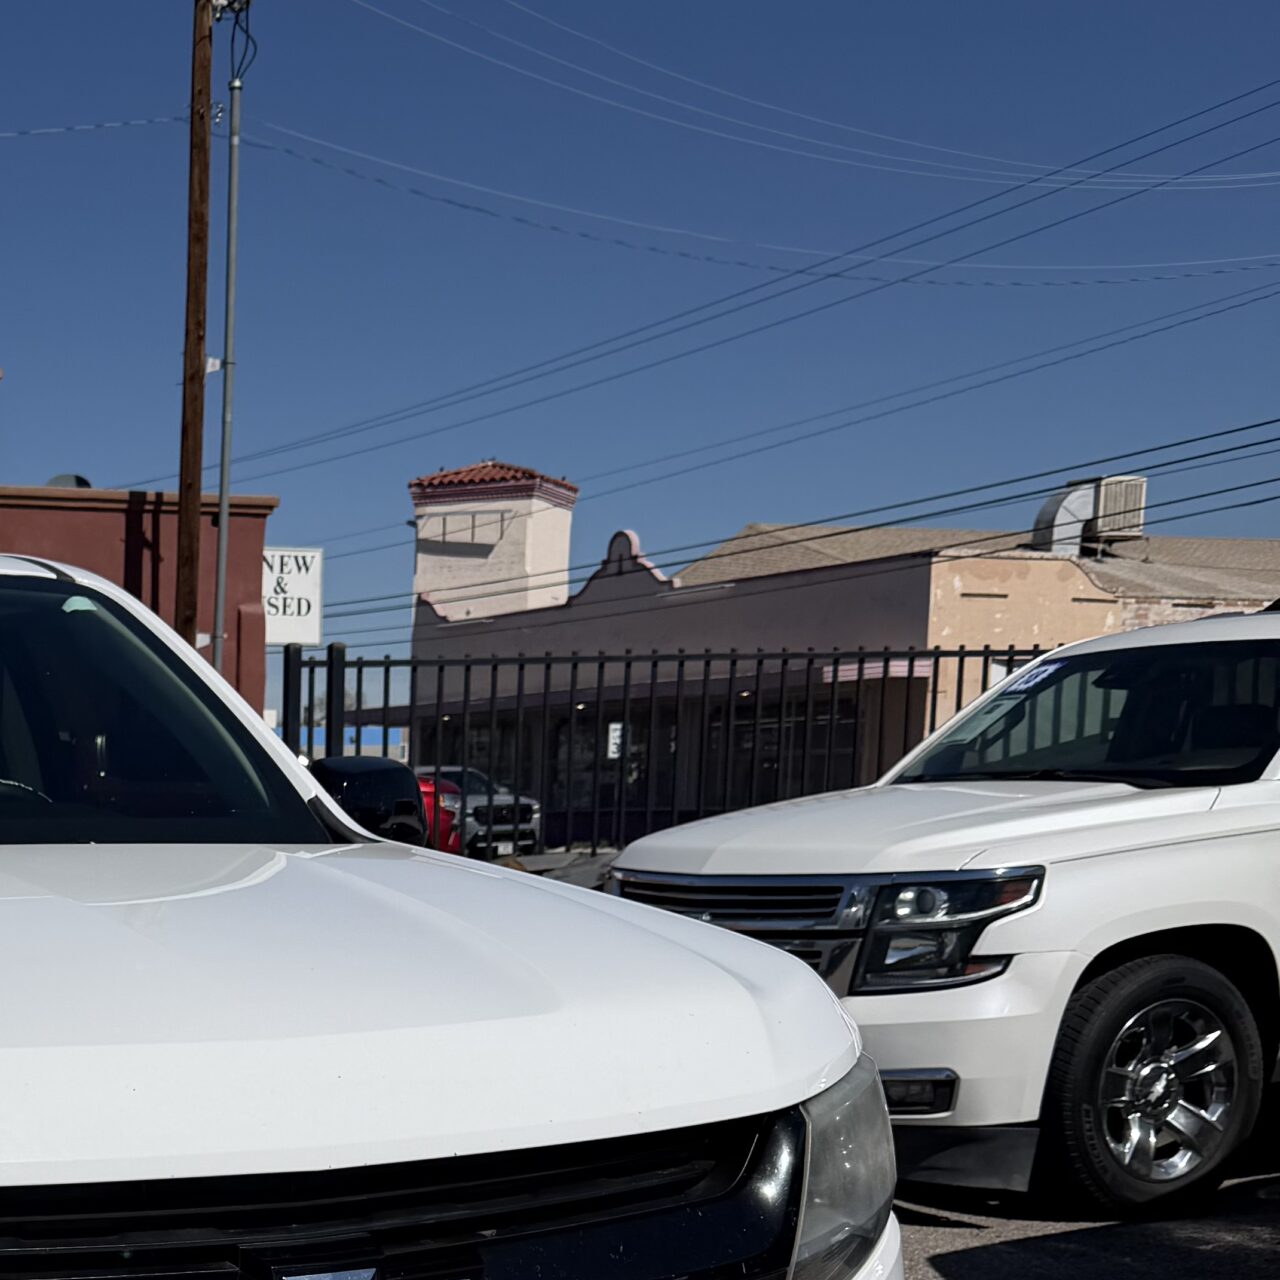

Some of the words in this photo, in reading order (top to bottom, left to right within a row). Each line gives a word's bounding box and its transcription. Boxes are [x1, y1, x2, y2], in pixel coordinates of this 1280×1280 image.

[263, 554, 315, 575] NEW
[273, 576, 288, 595] &
[263, 596, 311, 616] SED
